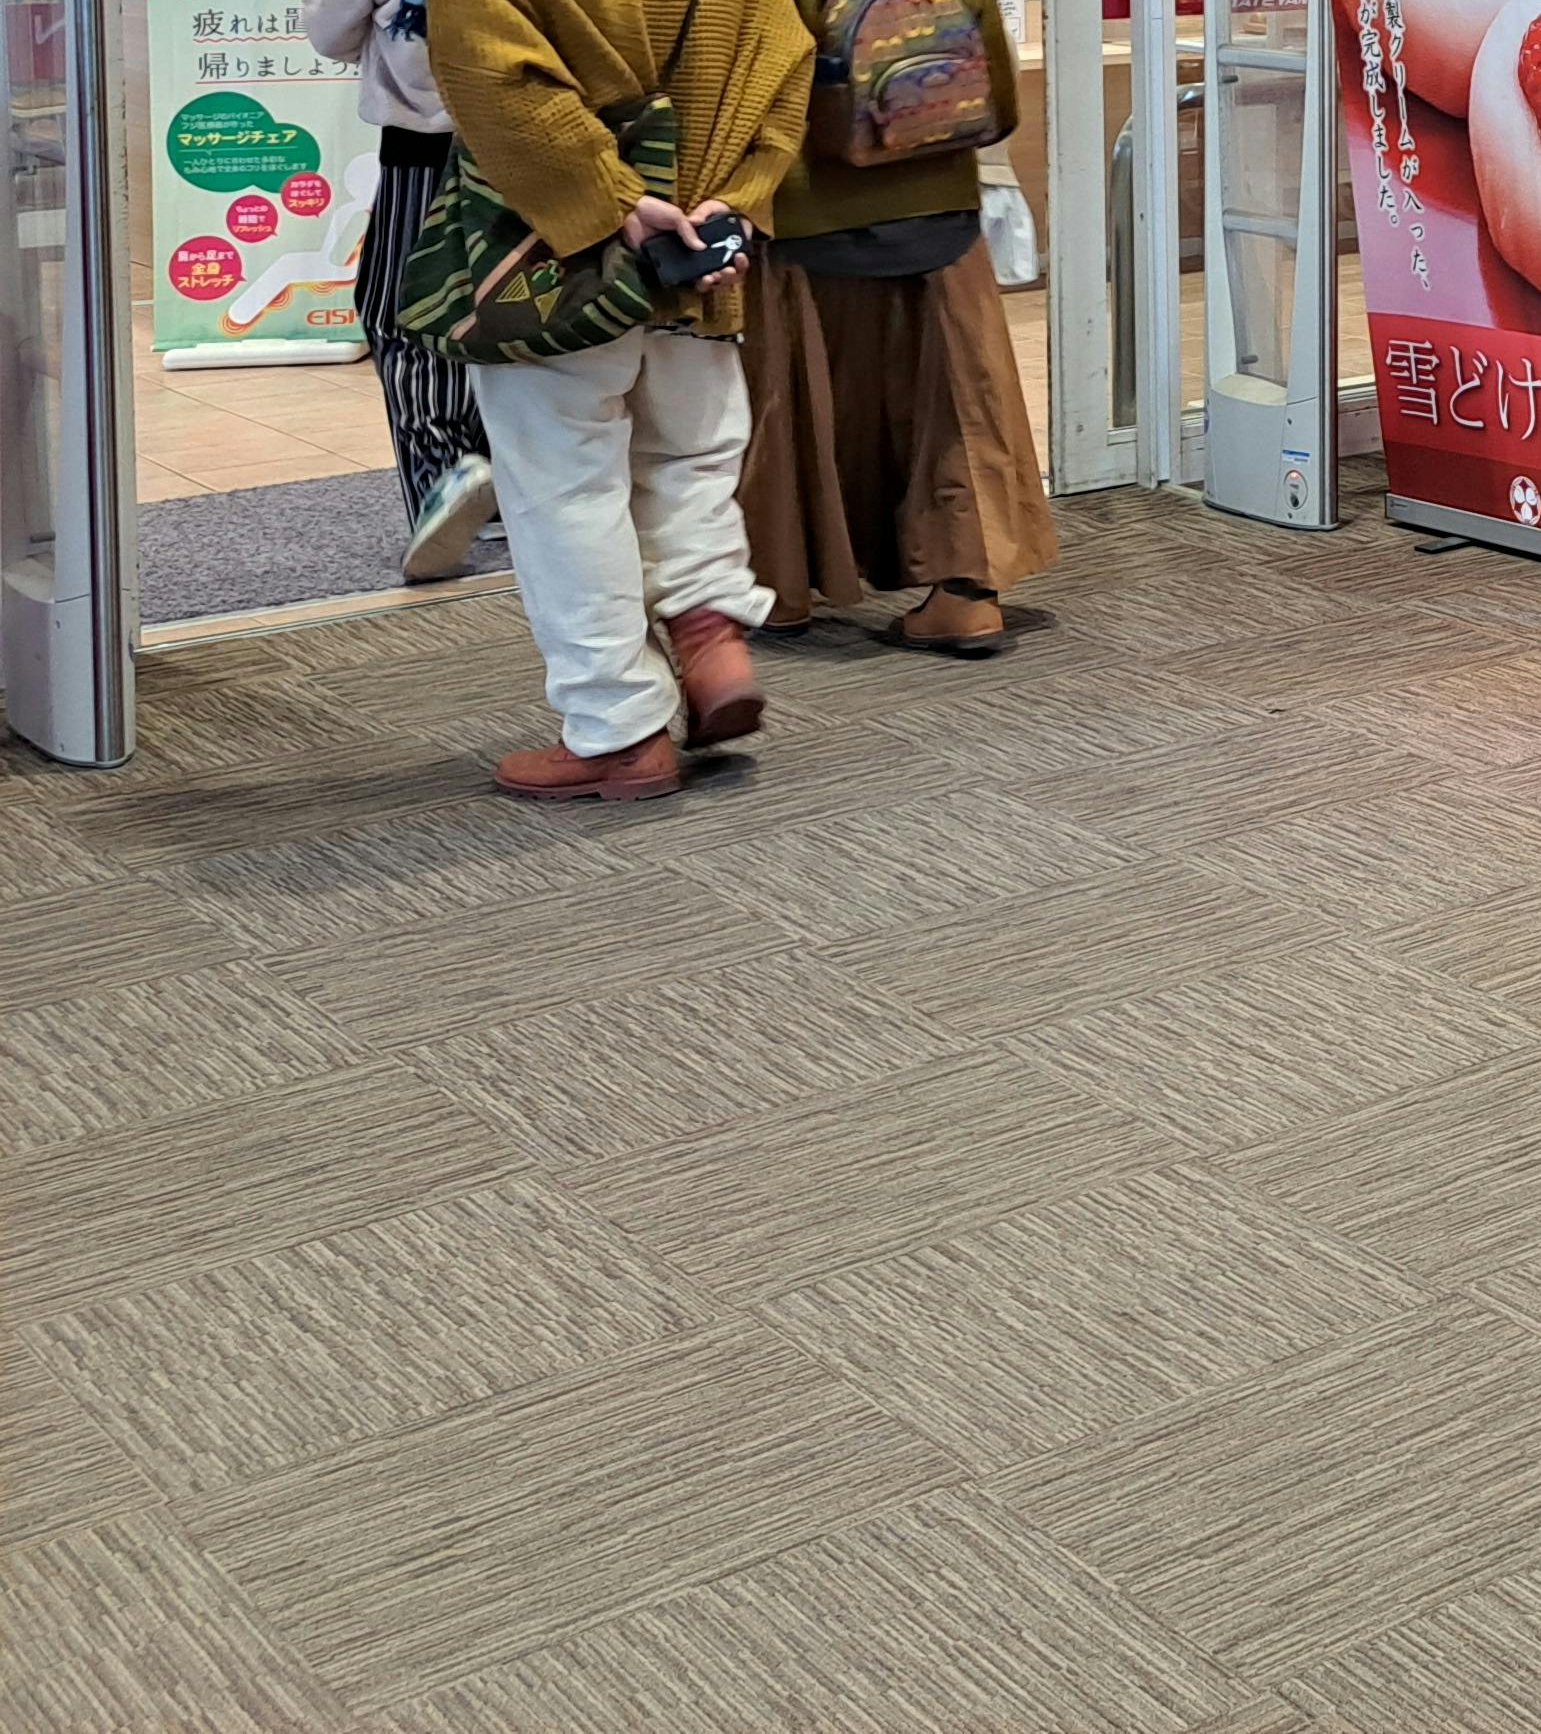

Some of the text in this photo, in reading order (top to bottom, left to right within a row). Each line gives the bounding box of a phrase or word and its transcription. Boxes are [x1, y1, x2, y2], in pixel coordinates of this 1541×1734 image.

[177, 129, 298, 147] マッサージチェア
